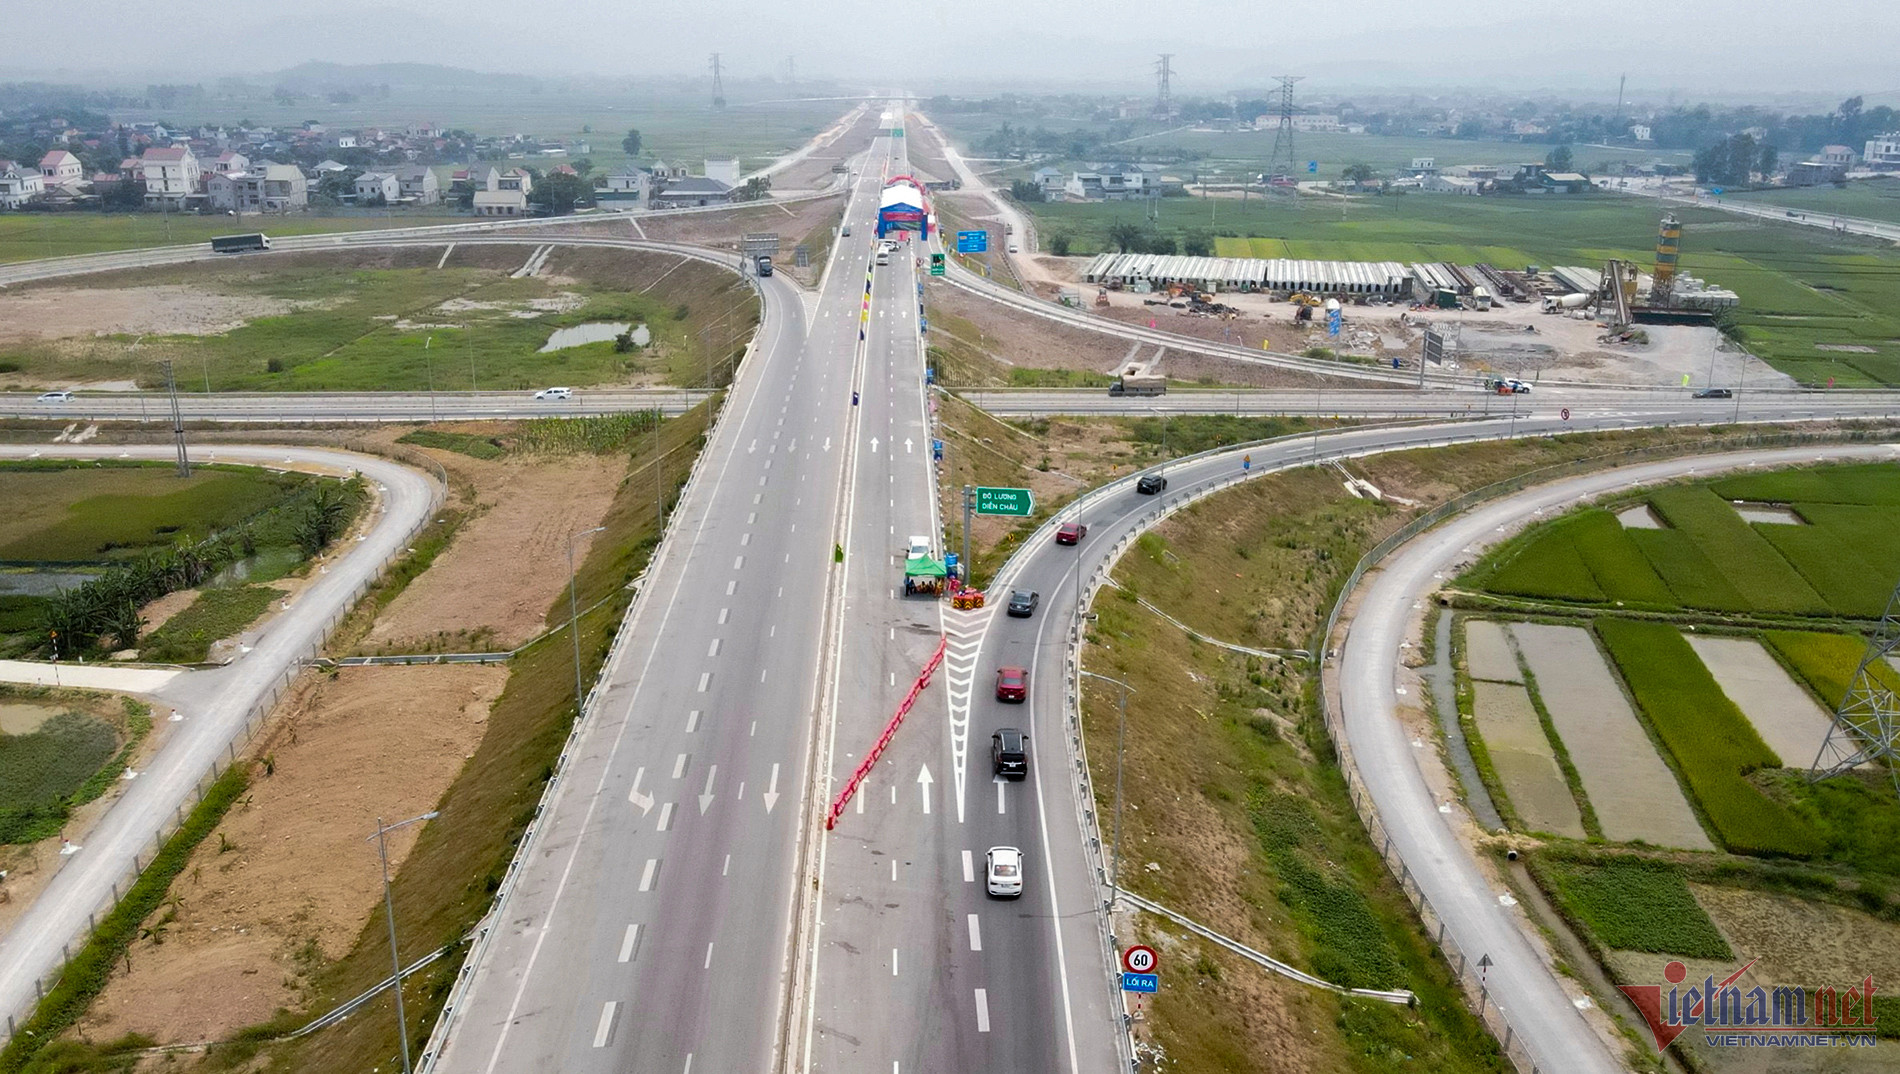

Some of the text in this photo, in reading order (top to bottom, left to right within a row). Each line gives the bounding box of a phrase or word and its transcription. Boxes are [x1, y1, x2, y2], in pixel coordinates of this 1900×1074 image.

[1133, 954, 1148, 966] 60
[1126, 976, 1155, 988] LỐI RA
